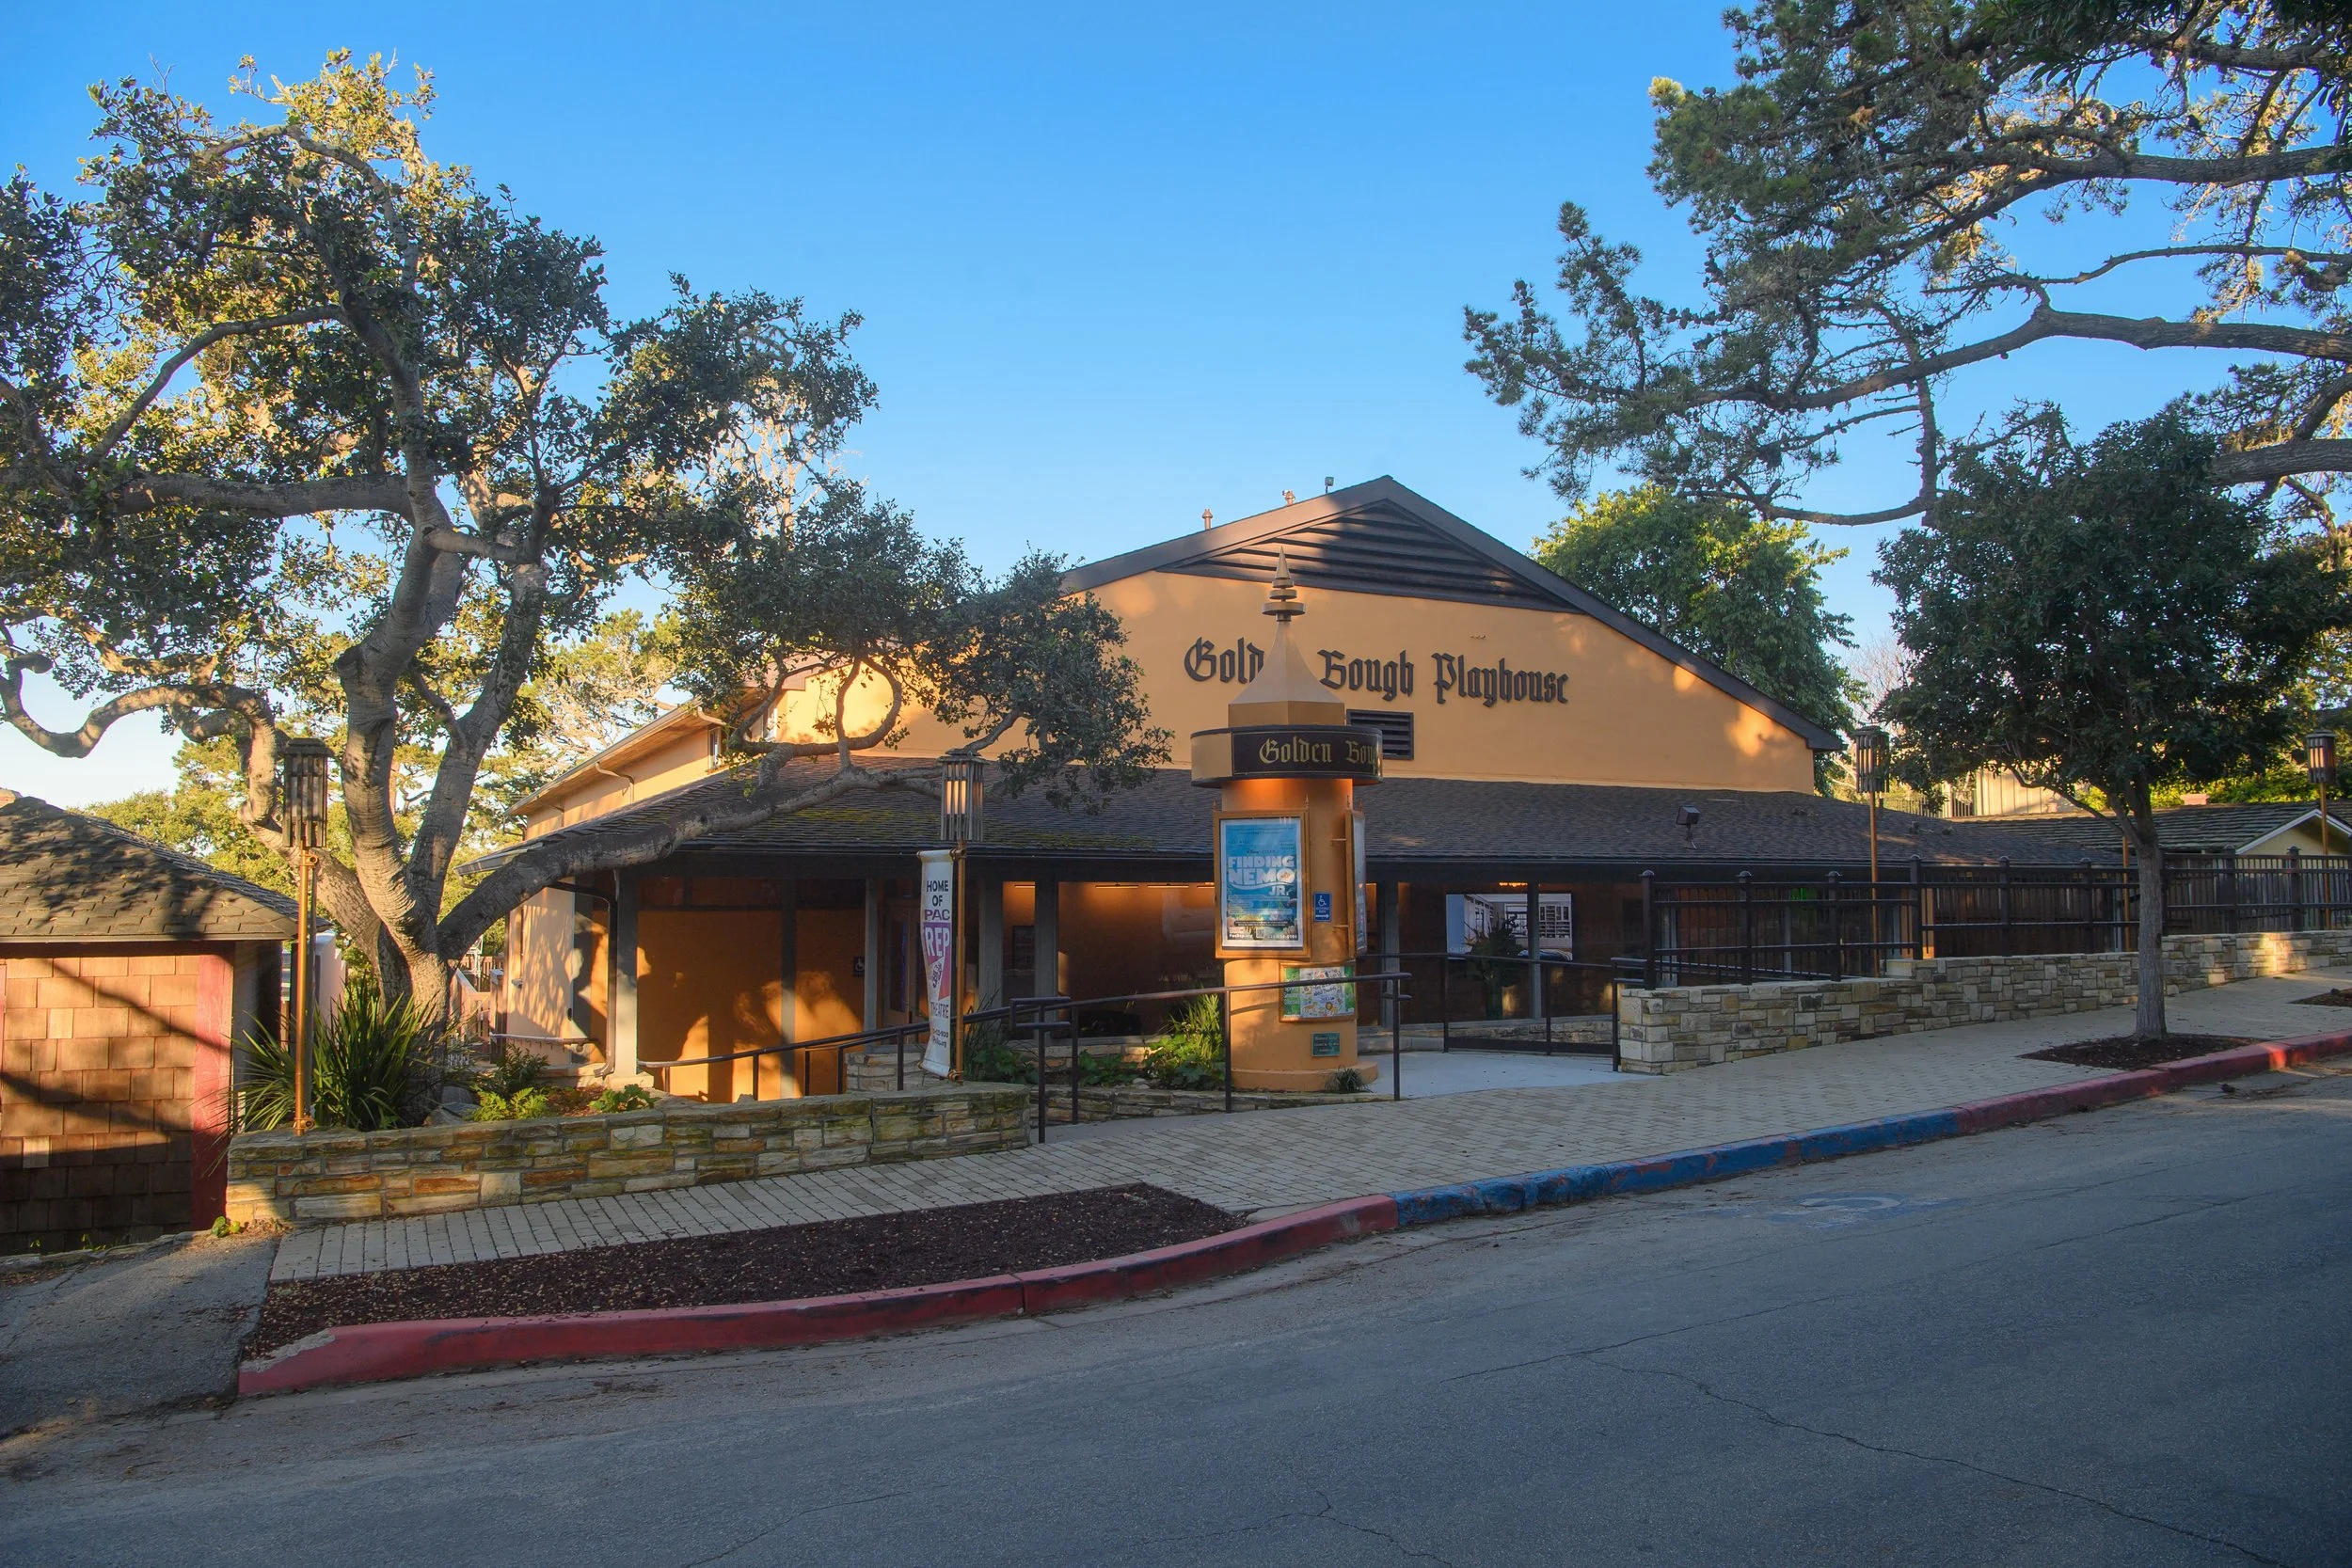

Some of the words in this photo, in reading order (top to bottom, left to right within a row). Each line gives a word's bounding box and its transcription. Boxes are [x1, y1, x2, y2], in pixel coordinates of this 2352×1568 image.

[1184, 637, 1265, 685] Gold
[1317, 649, 1415, 702] Bough
[1431, 652, 1569, 707] Playhouse
[1259, 736, 1332, 764] Golden
[1228, 855, 1295, 868] FINDING
[1228, 867, 1295, 885] NEMO
[927, 880, 949, 893] HOME
[1269, 885, 1289, 896] JR.
[932, 895, 943, 907] OF
[924, 909, 950, 921] PAC
[925, 927, 950, 957] REP
